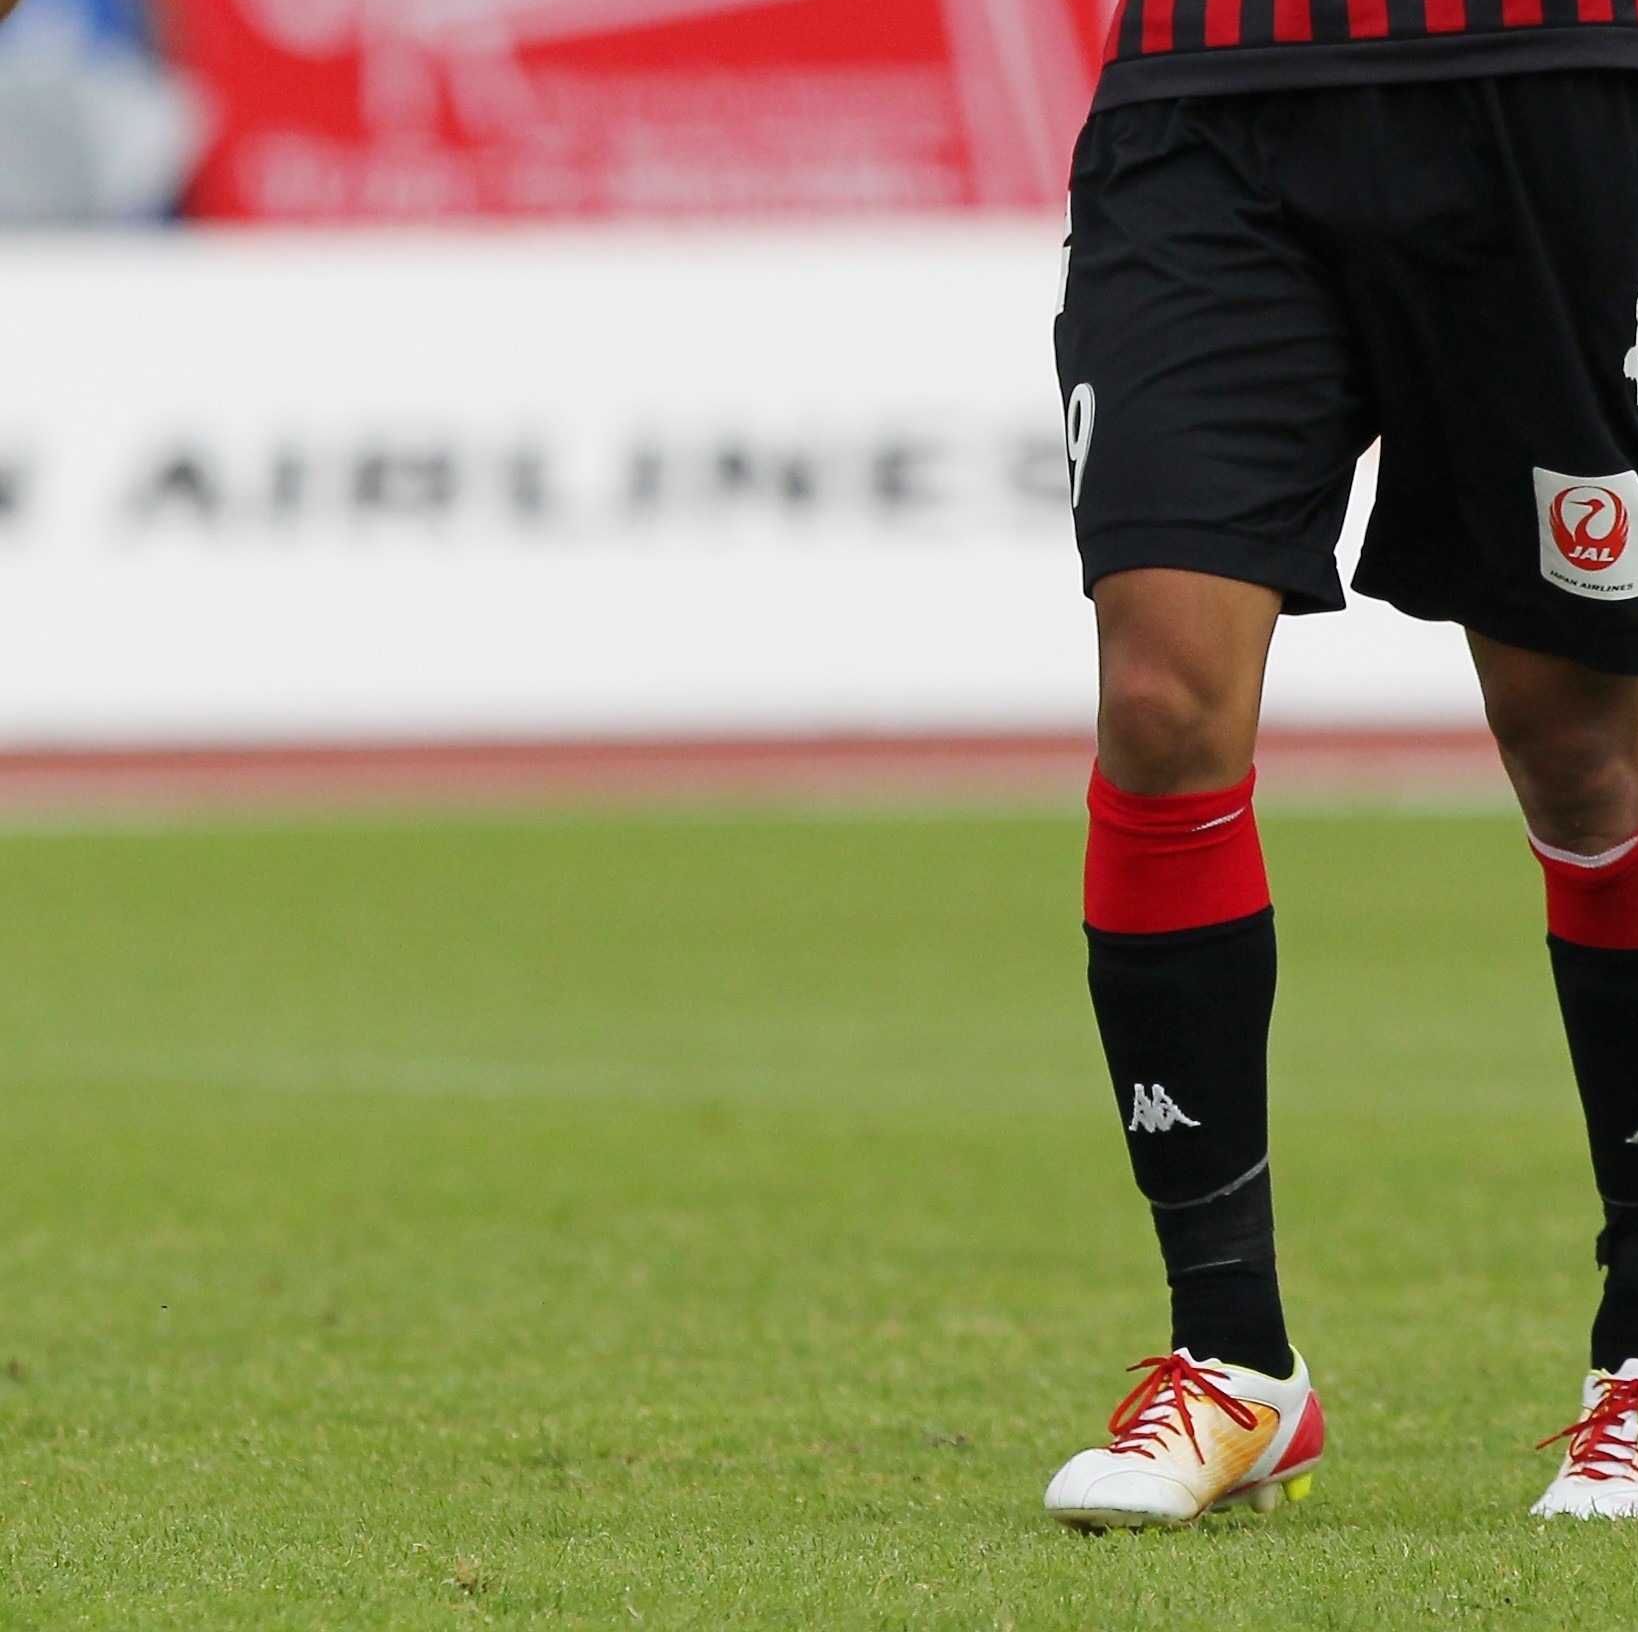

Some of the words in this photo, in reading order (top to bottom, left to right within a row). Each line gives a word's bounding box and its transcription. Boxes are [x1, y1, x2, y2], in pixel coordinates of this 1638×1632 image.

[1067, 382, 1096, 509] 9
[1568, 545, 1615, 562] JAL
[1580, 582, 1634, 592] AIRLINES
